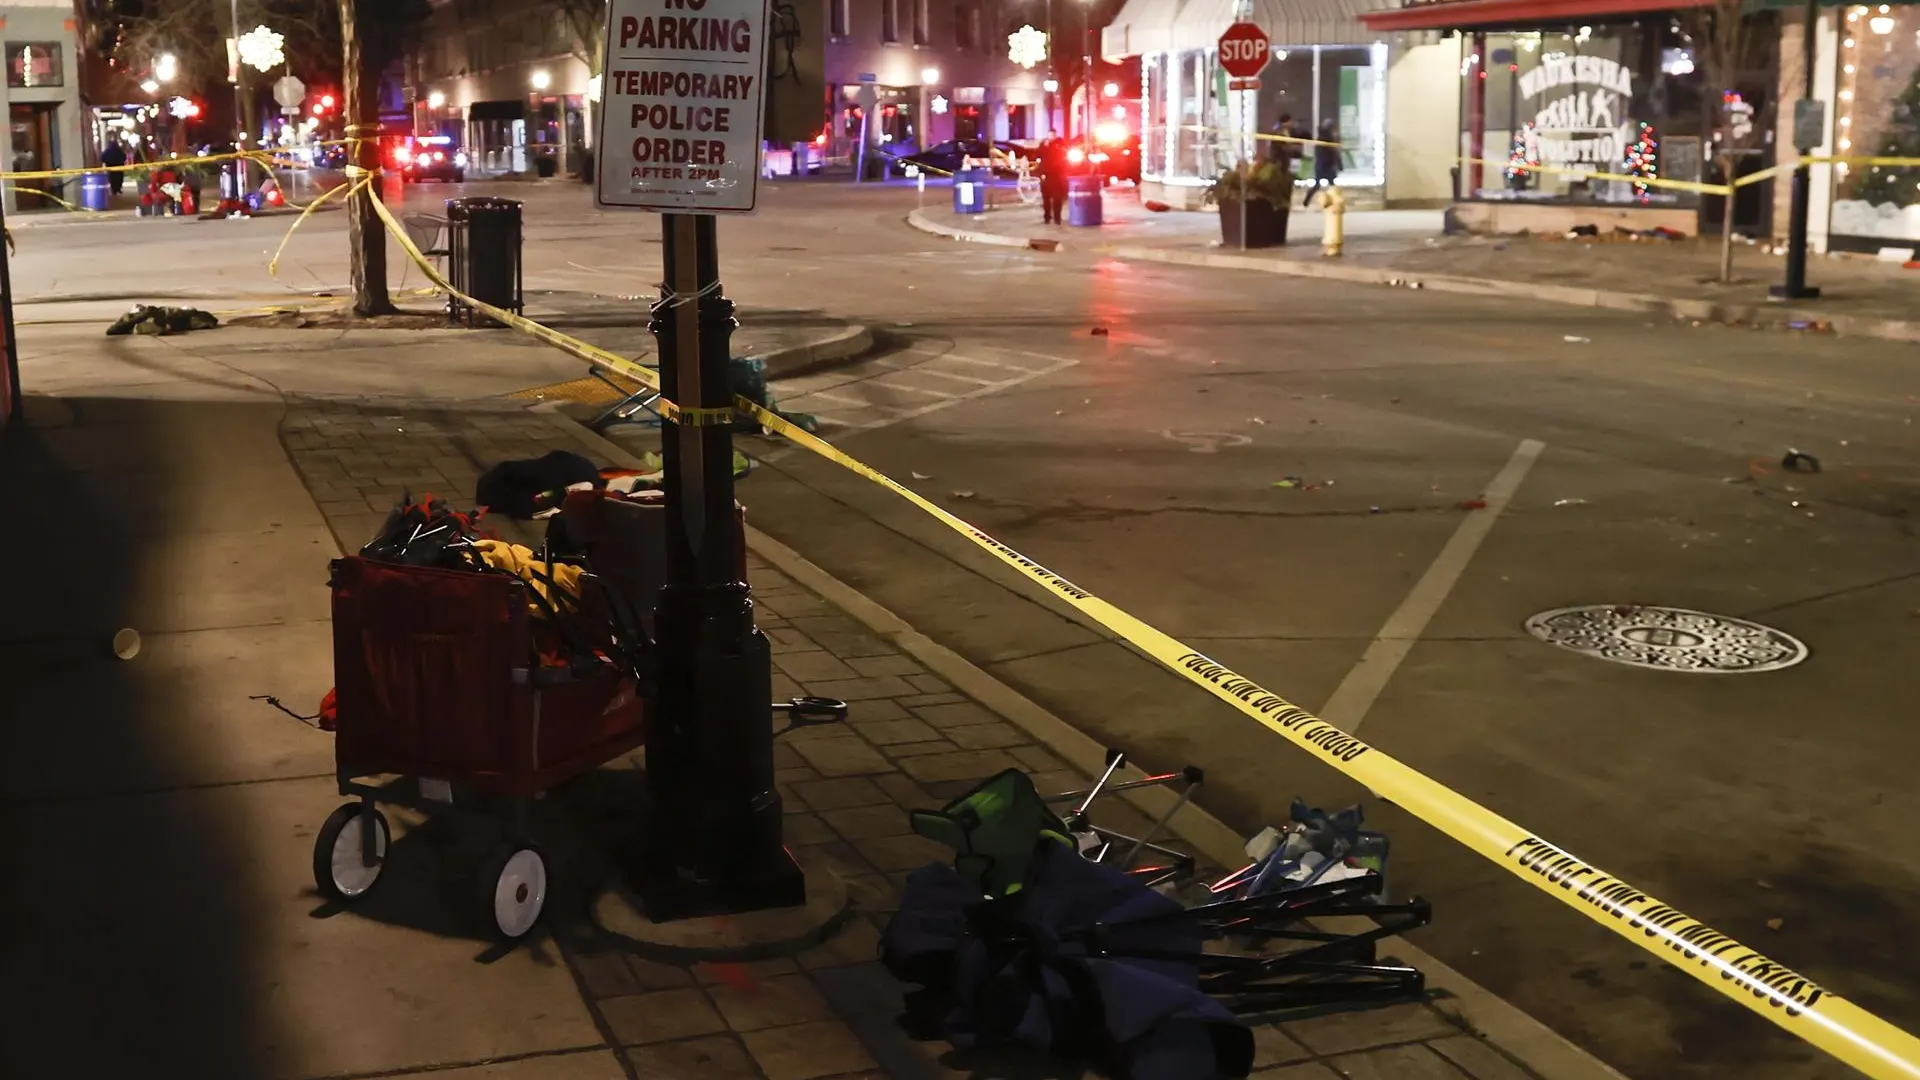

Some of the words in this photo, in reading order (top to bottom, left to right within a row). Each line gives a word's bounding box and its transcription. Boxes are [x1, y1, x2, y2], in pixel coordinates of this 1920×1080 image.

[620, 16, 750, 53] PARKING
[1221, 39, 1267, 60] STOP
[613, 71, 753, 100] TEMPORARY
[1519, 55, 1633, 100] WAUKESHA
[631, 104, 730, 132] POLICE
[632, 137, 726, 165] ORDER
[631, 167, 682, 179] AFTER
[688, 168, 720, 180] 2PM
[1505, 838, 1593, 890] POLICE
[1577, 877, 1647, 919] LINE
[1628, 904, 1688, 937] DO
[1664, 924, 1741, 967] NOT
[1721, 953, 1833, 1017] CROSS
